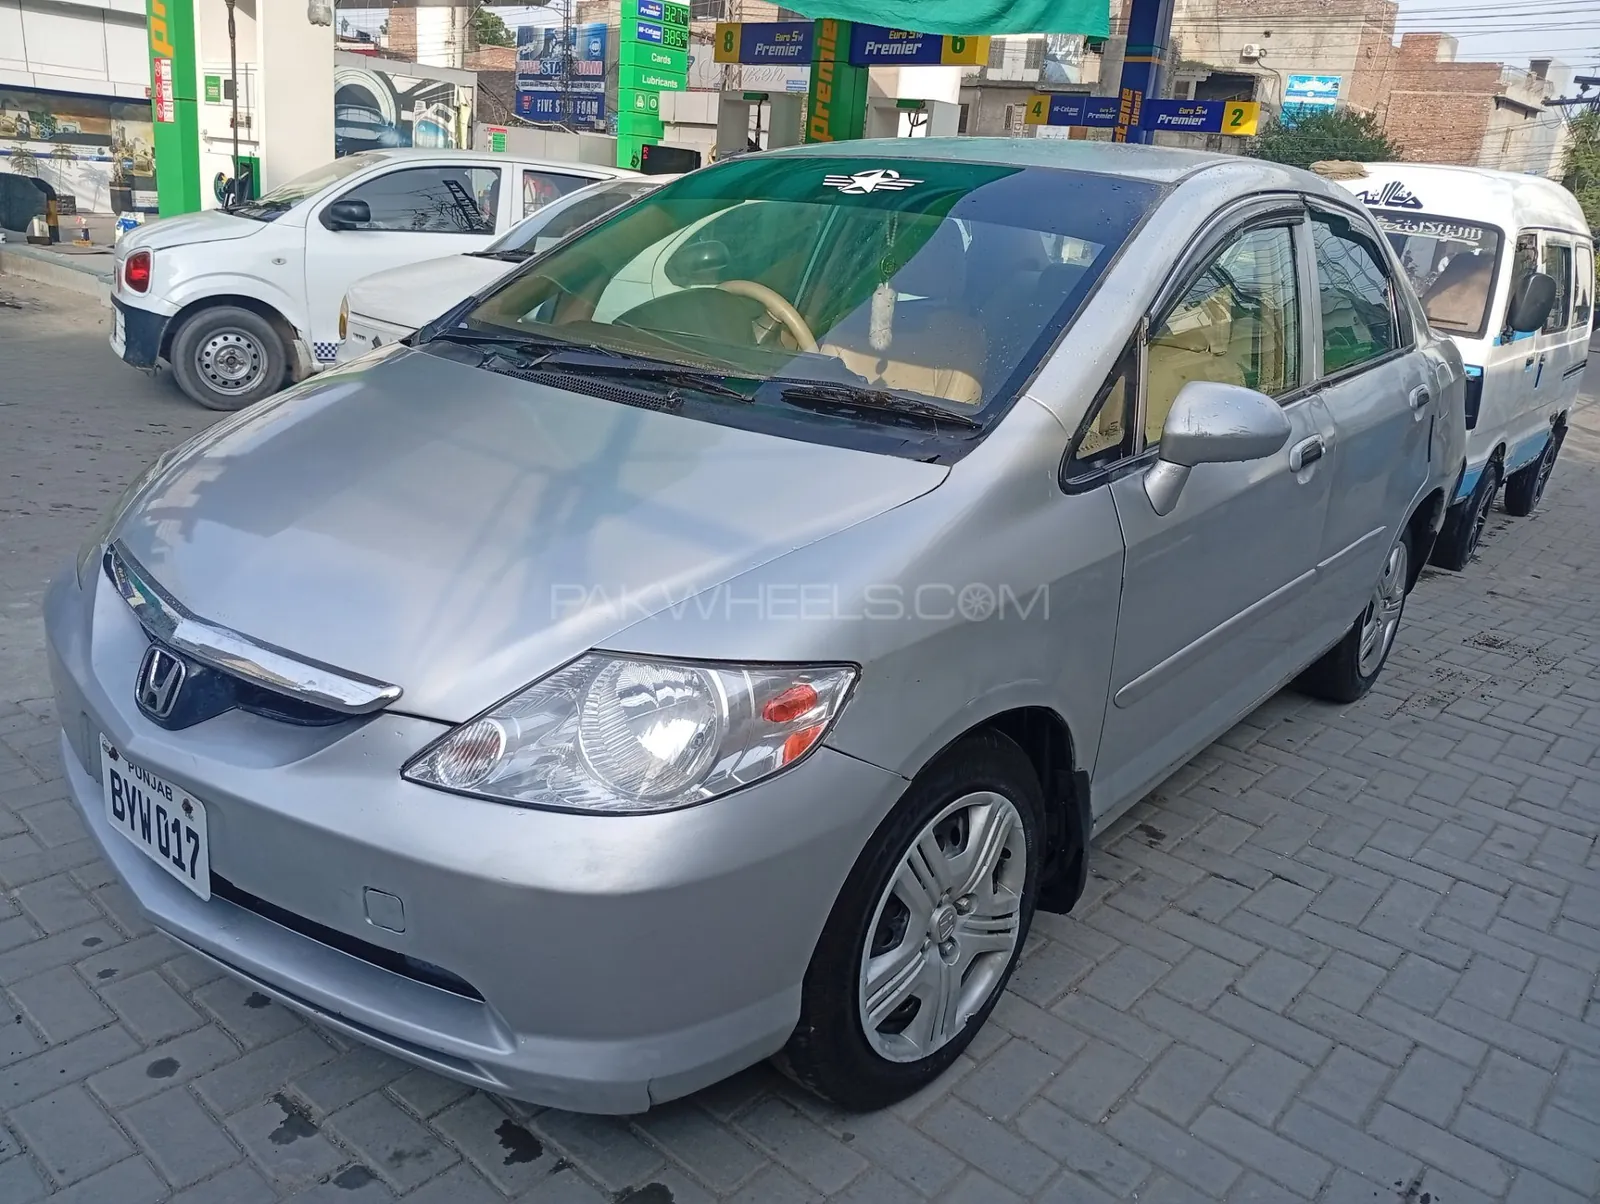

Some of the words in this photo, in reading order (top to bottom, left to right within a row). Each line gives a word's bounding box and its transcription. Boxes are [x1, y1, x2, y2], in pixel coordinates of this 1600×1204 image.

[723, 31, 734, 53] 8
[775, 33, 790, 41] Euro
[889, 31, 907, 39] Euro
[754, 43, 803, 56] Premier
[865, 41, 922, 55] Premier
[951, 36, 965, 54] 6
[651, 52, 672, 65] Cards
[573, 61, 603, 75] OAM
[641, 74, 678, 89] Lubricants
[810, 19, 838, 142] premie
[537, 98, 553, 113] FIVE
[576, 100, 599, 115] FOAM
[1032, 101, 1042, 117] 4
[1087, 112, 1116, 120] Premier
[1157, 114, 1206, 126] Premier
[1230, 108, 1244, 127] 2
[128, 761, 173, 802] PUNJAB
